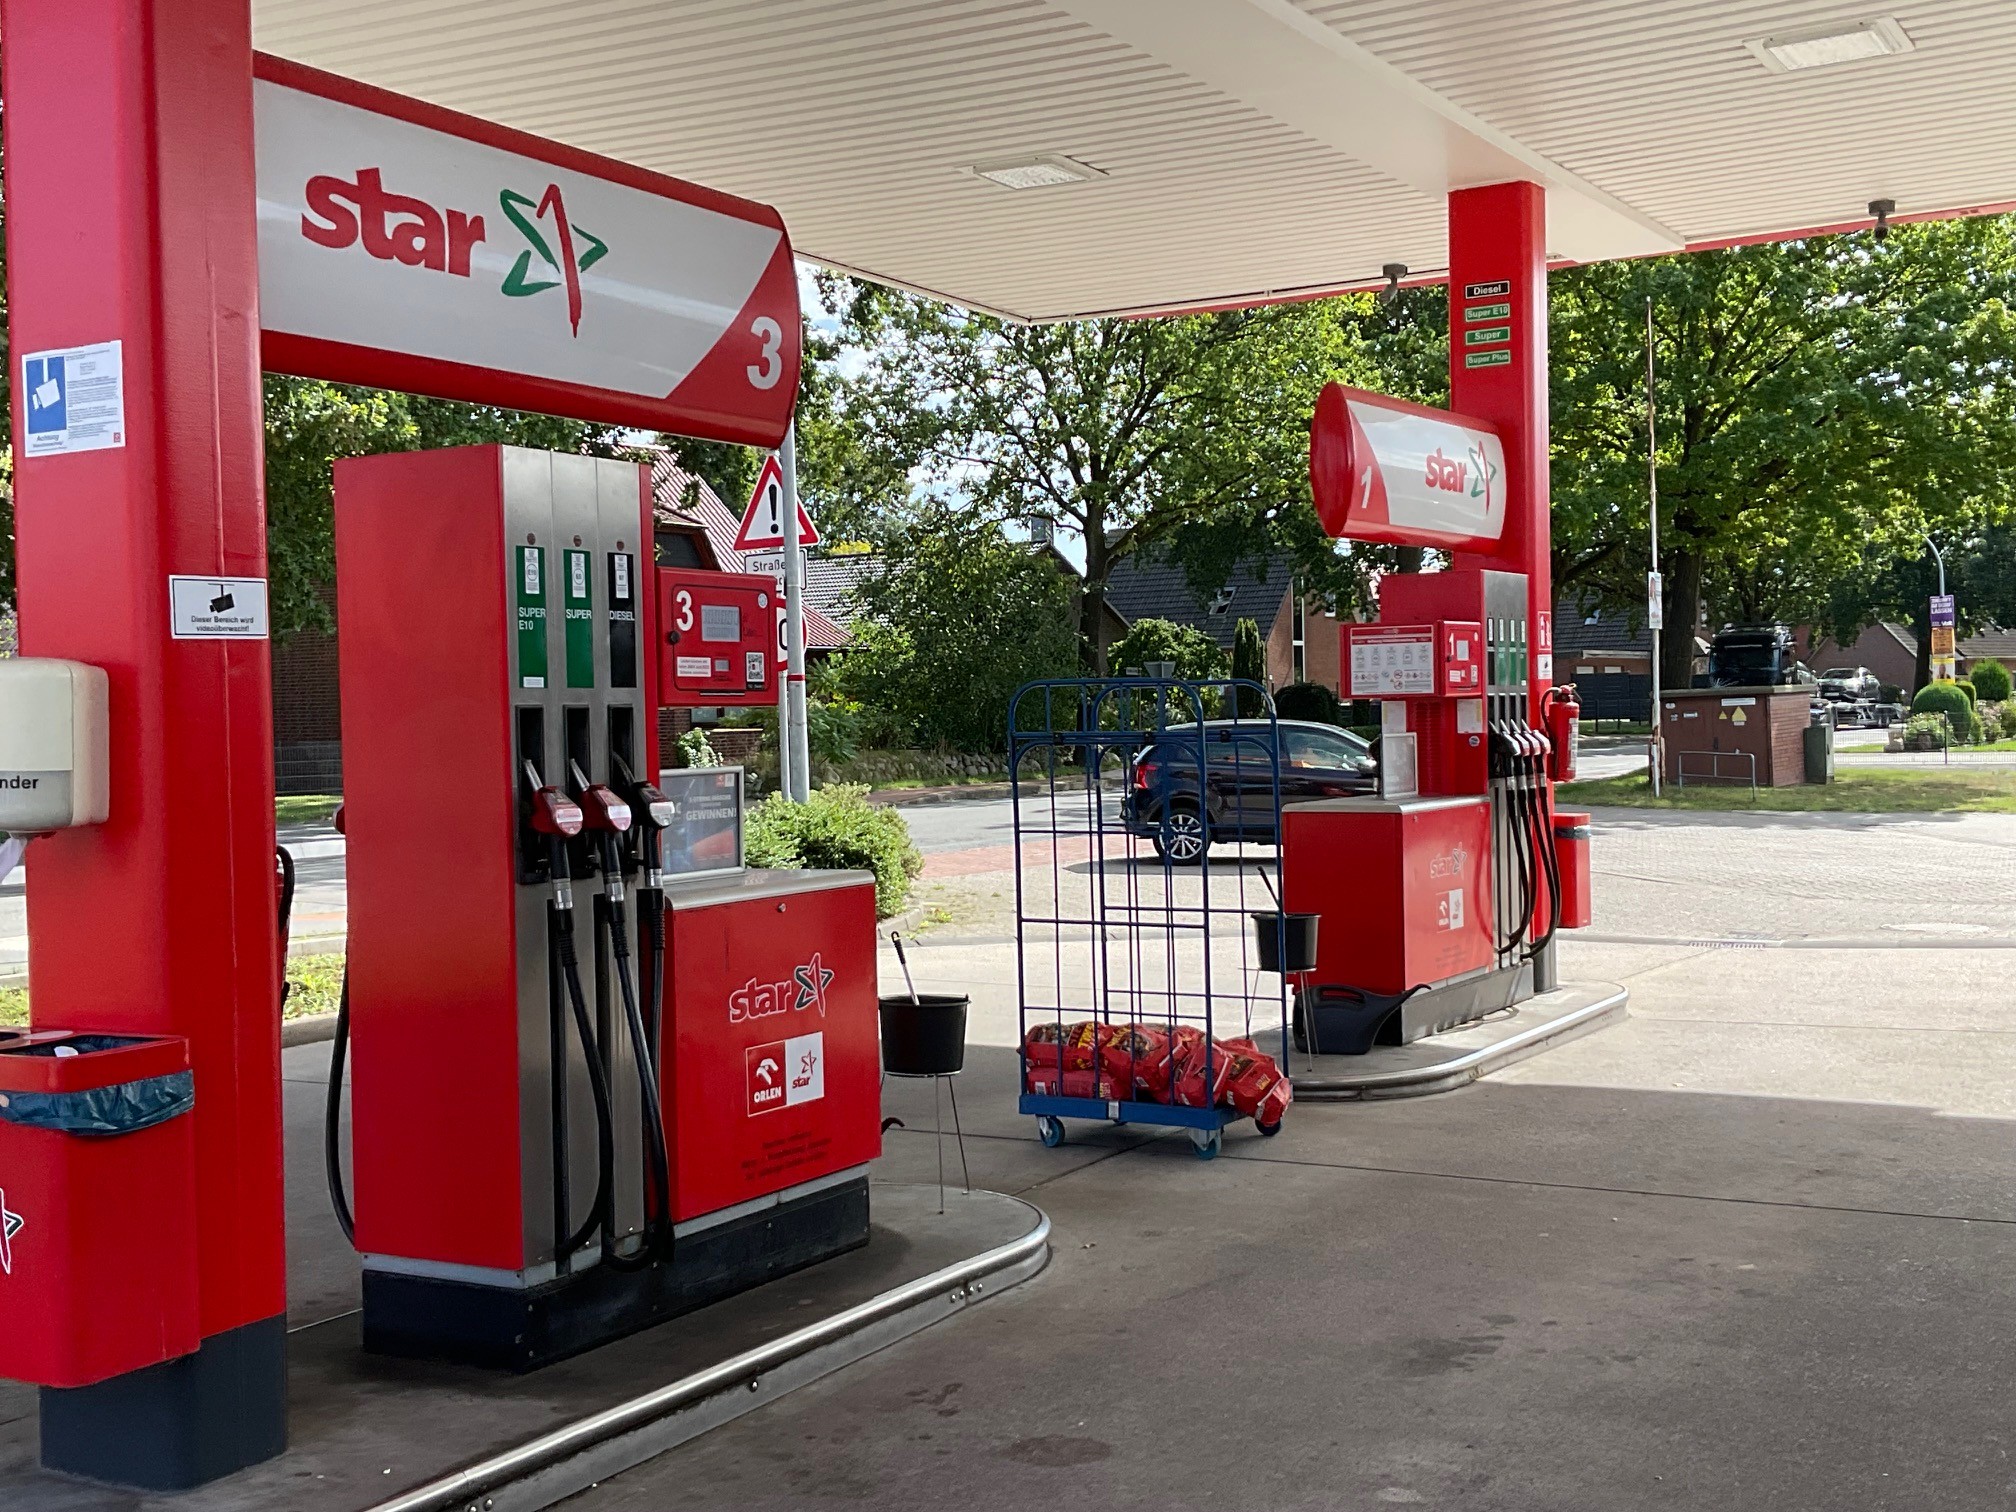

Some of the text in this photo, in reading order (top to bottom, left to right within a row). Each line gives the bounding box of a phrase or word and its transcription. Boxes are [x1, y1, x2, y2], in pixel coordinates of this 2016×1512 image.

[301, 167, 486, 278] star
[1473, 284, 1502, 296] Diesel
[1467, 306, 1508, 318] Super E10
[1474, 331, 1501, 341] Super
[746, 316, 782, 390] 3
[1468, 353, 1508, 364] Super Plus
[1425, 447, 1467, 494] star
[1361, 465, 1372, 509] 1
[752, 559, 786, 572] Straße
[518, 606, 546, 618] SUPER
[565, 608, 592, 620] SUPER
[609, 610, 635, 621] DIESEL
[676, 590, 694, 631] 3
[191, 615, 212, 623] Dieser
[518, 620, 534, 630] E10
[1449, 632, 1455, 656] 1
[0, 775, 39, 789] nder
[686, 806, 737, 821] GEWINNEN!
[1429, 853, 1452, 879] star
[729, 977, 792, 1023] star
[792, 1076, 811, 1089] star
[753, 1085, 782, 1103] ORLEN
